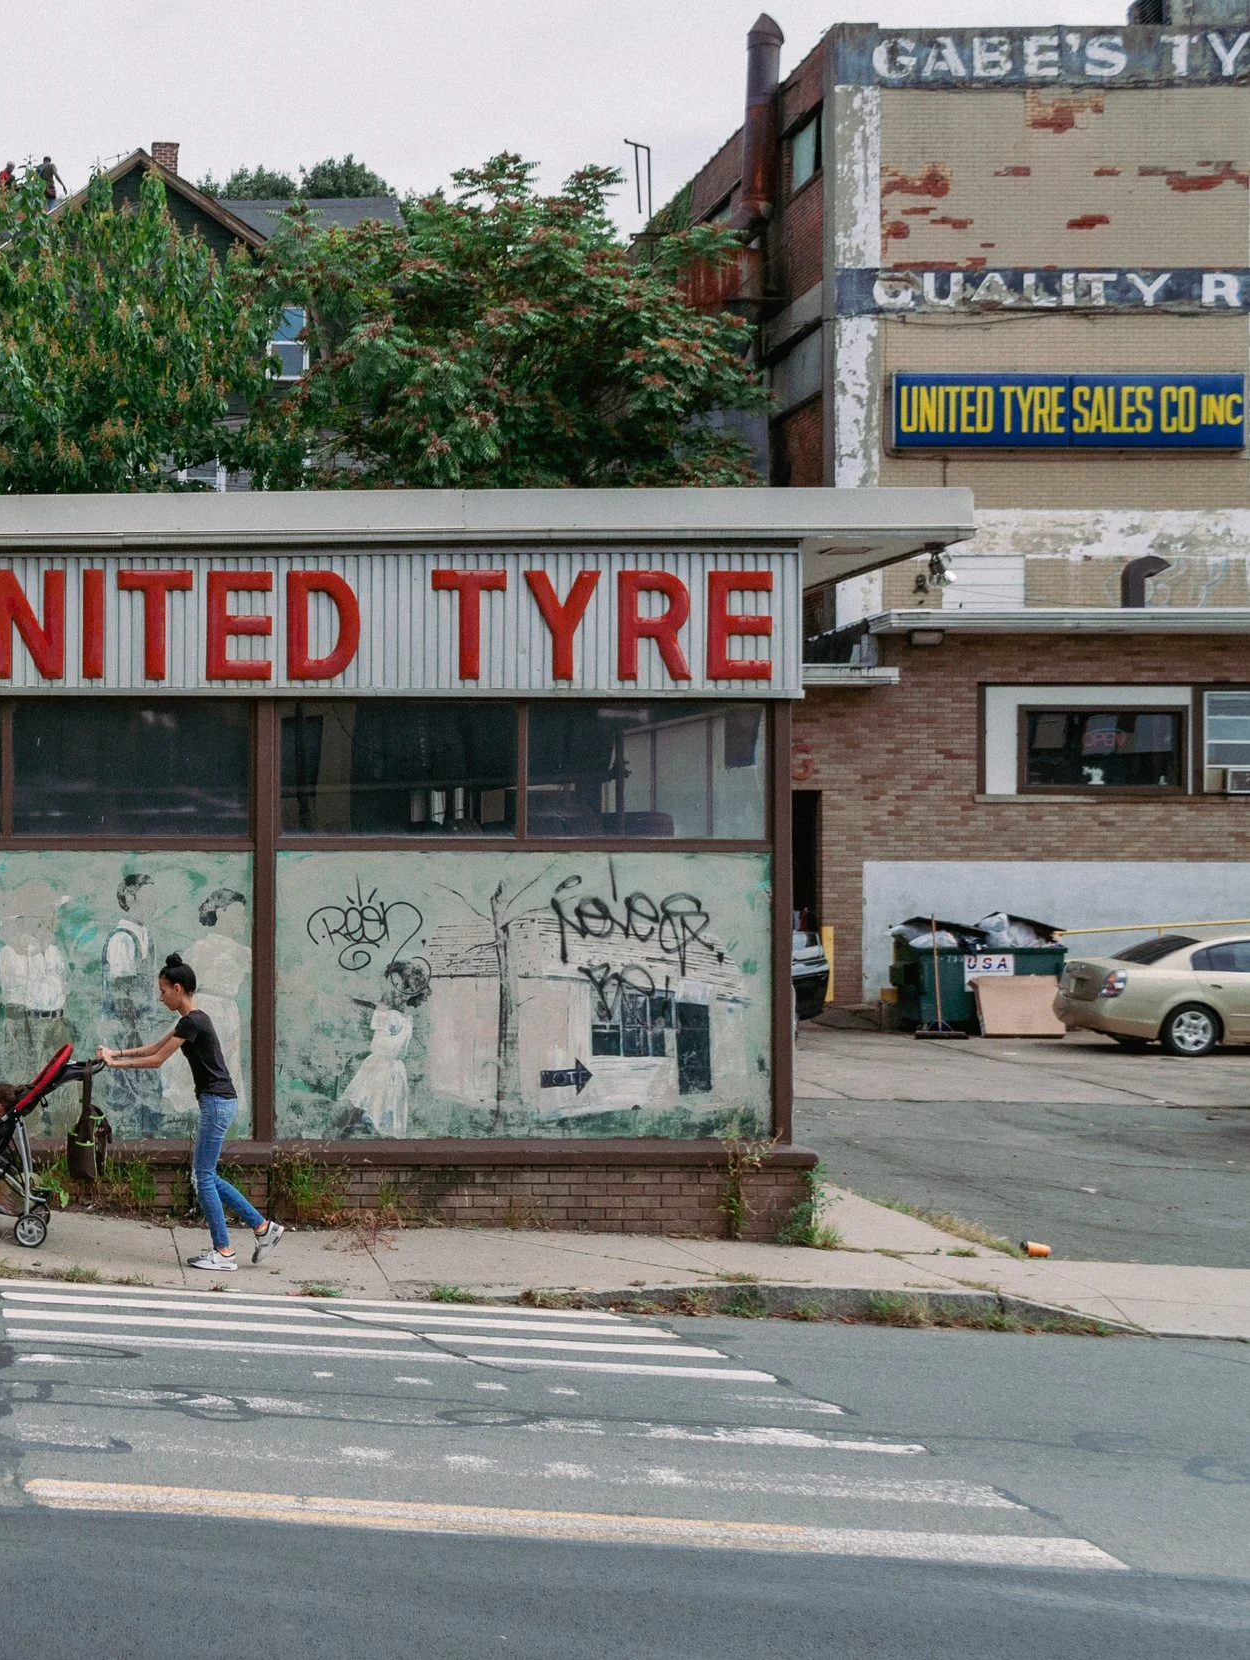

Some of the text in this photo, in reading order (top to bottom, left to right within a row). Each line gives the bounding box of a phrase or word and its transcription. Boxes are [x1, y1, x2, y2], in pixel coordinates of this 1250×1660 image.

[872, 32, 1128, 79] GABE'S
[900, 385, 1243, 433] UNITED TYRE SALES CO INC
[431, 568, 774, 682] TYRE
